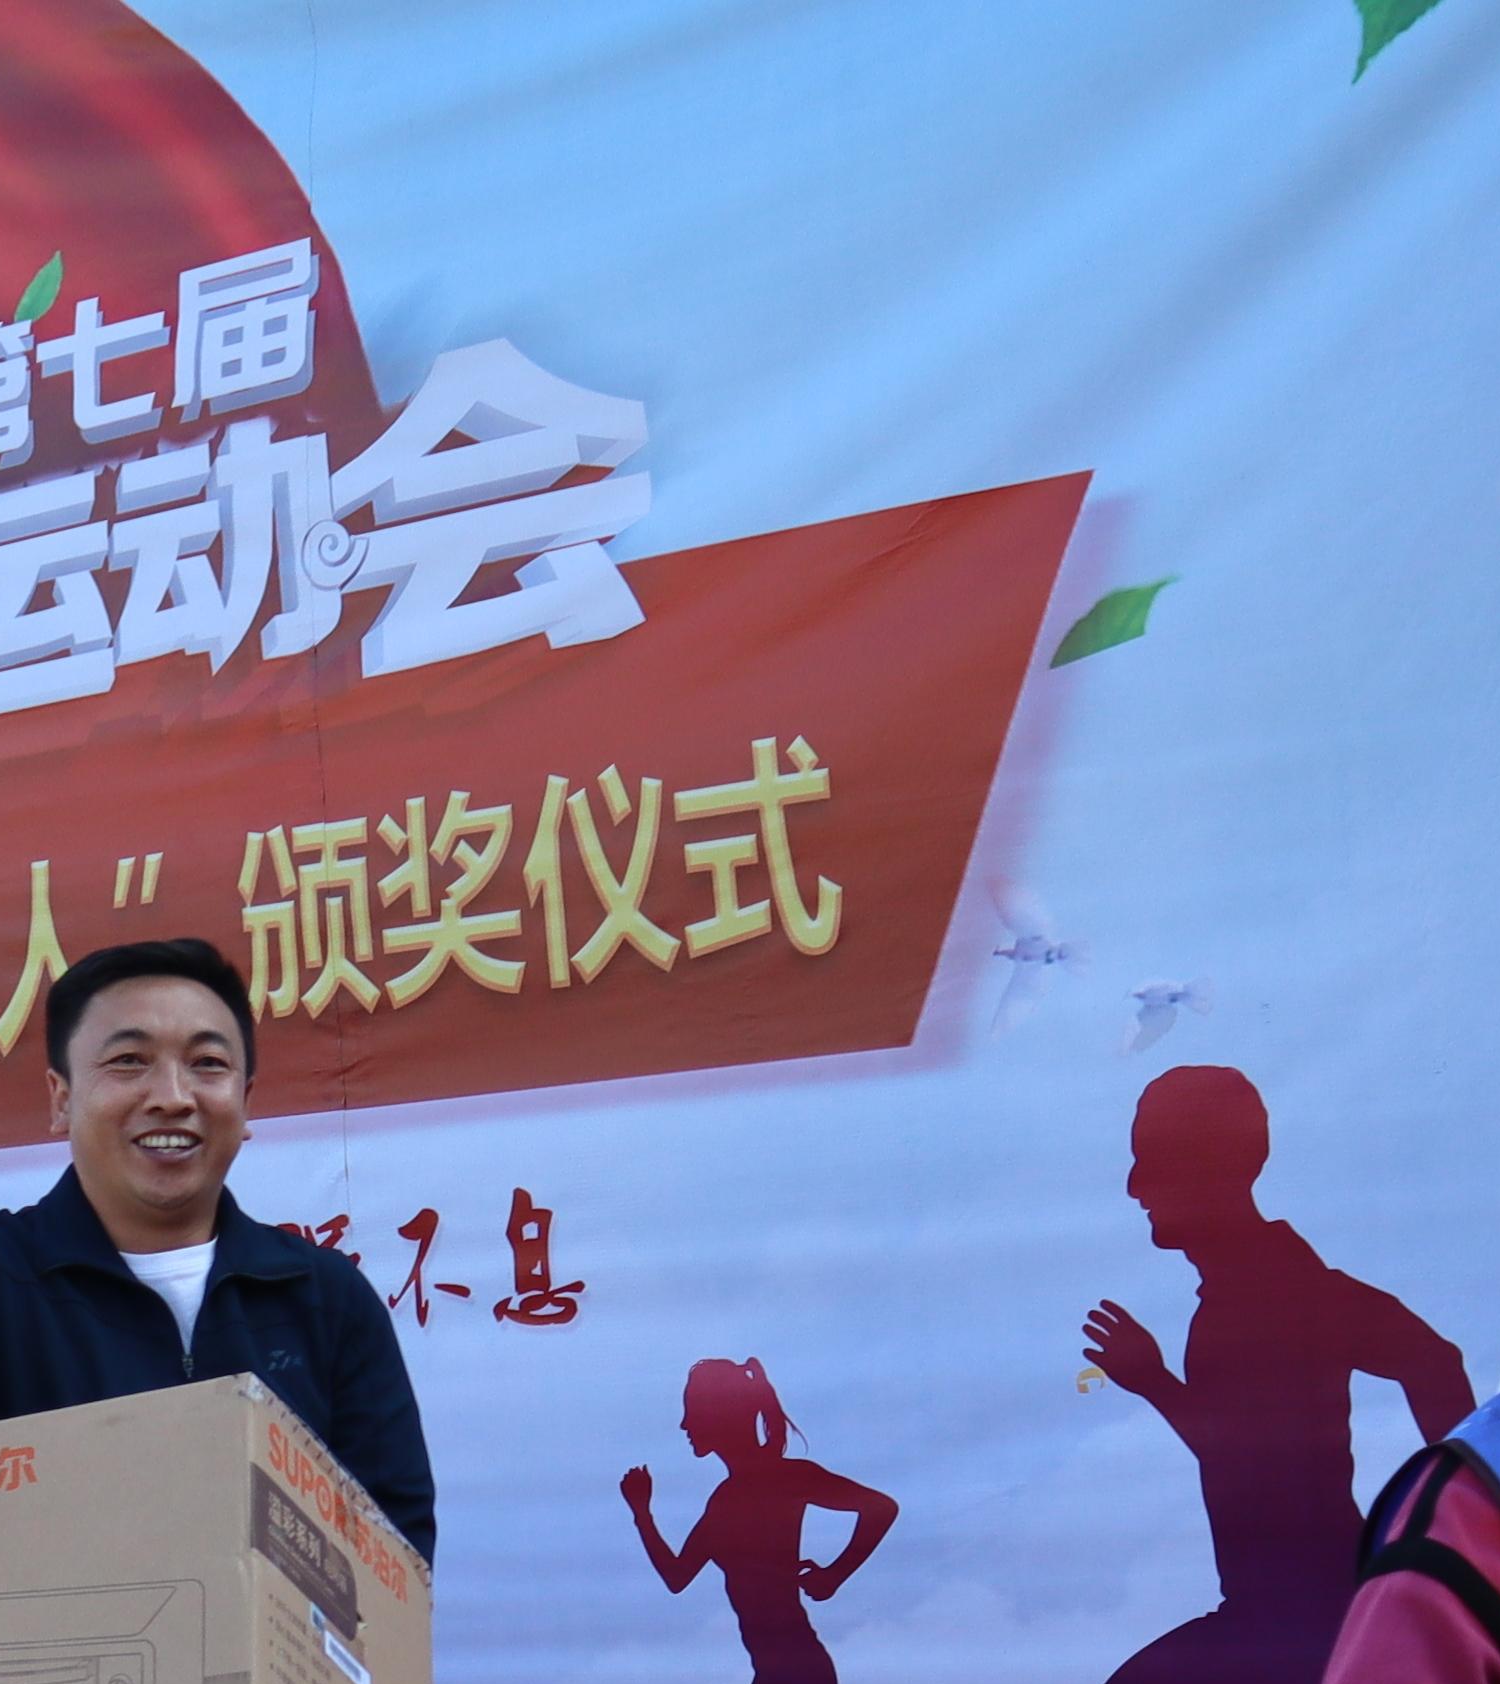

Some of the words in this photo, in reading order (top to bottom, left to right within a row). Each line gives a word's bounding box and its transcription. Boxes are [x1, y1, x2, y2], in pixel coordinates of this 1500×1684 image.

[236, 734, 844, 1023] 颁奖仪式
[267, 1422, 350, 1543] SUPOR
